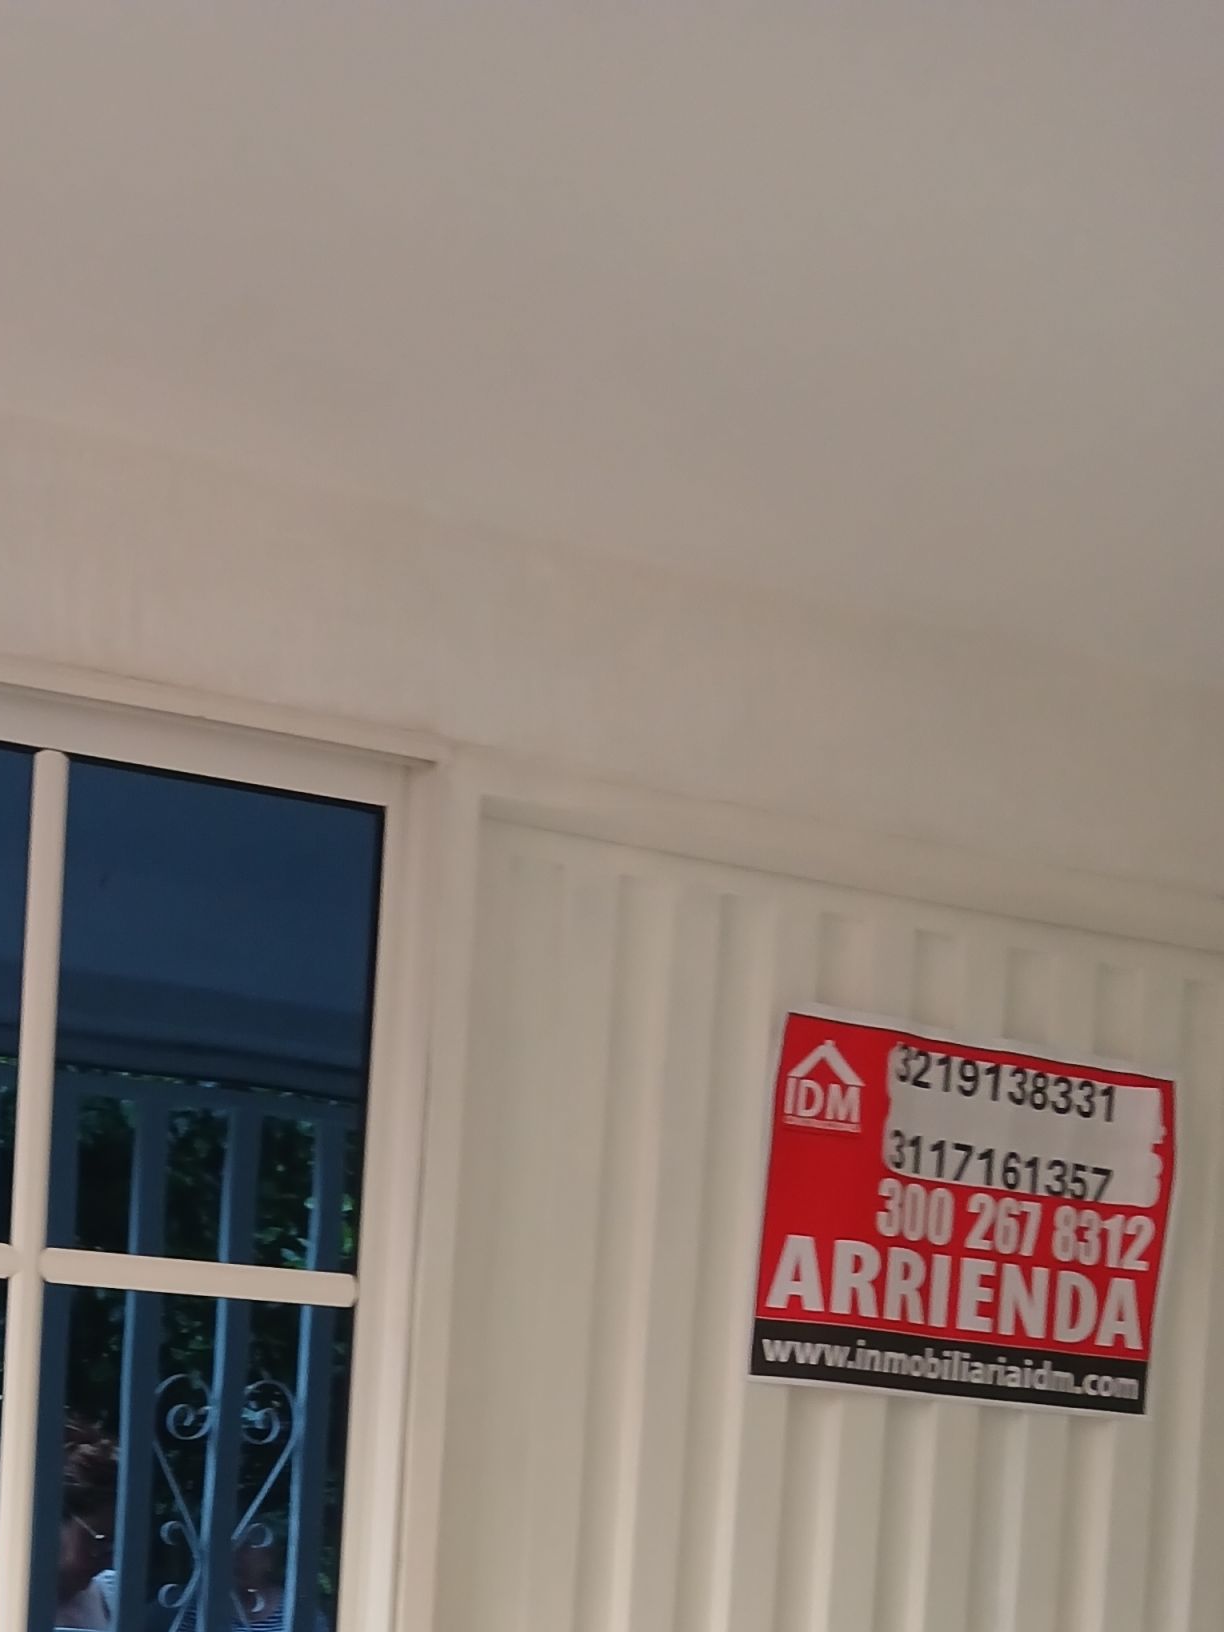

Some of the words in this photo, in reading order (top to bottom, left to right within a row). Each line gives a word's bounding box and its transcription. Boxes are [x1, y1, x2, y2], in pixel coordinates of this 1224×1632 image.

[784, 1075, 861, 1124] IDM
[895, 1045, 1115, 1122] 3219138331
[888, 1130, 1113, 1203] 3117161357
[876, 1178, 955, 1246] 300
[965, 1192, 1042, 1257] 267
[1053, 1208, 1154, 1271] 8312
[766, 1234, 1143, 1350] ARRIENDA
[762, 1336, 1138, 1401] www.inmobiliariaidm.com
